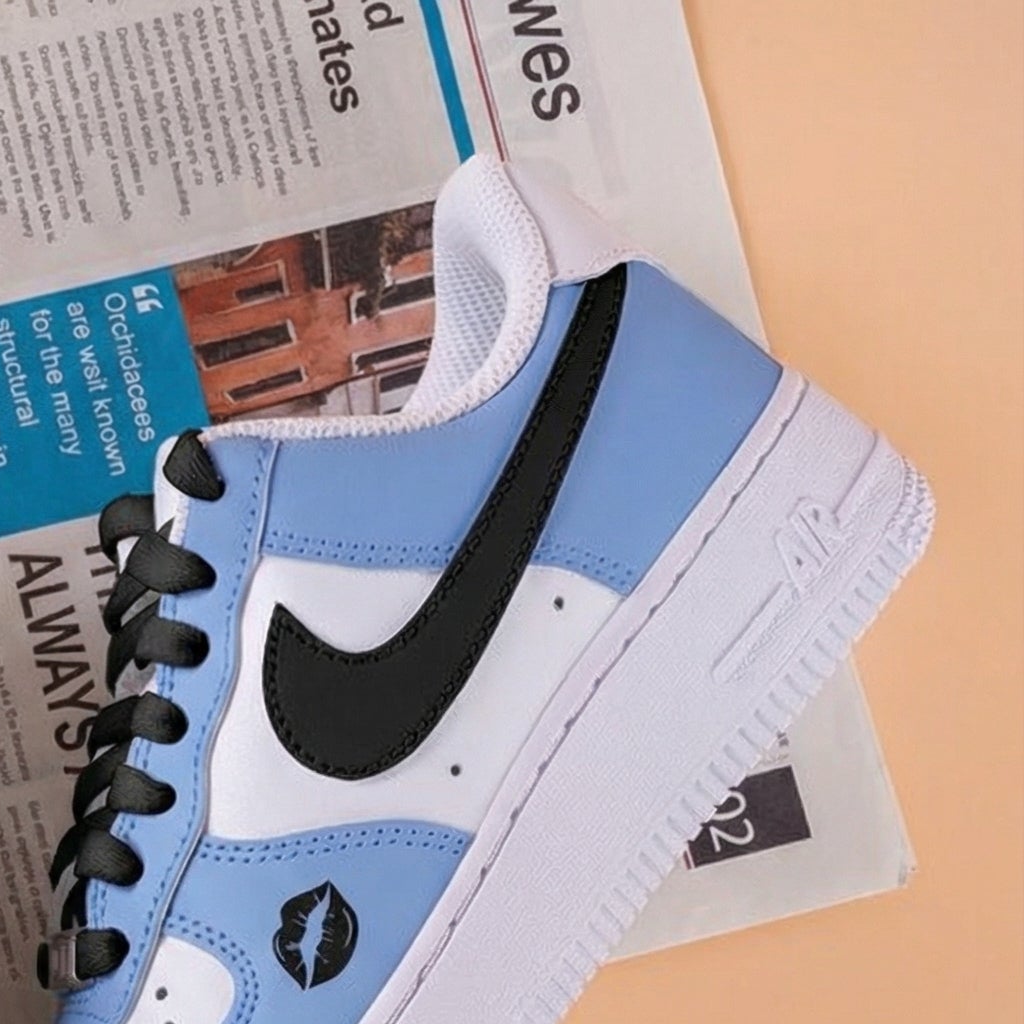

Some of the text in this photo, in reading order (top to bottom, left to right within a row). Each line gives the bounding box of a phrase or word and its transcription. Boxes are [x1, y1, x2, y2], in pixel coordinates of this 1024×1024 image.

[360, 0, 405, 31] d
[30, 308, 82, 455] for the many
[66, 301, 91, 339] are
[92, 398, 125, 476] known
